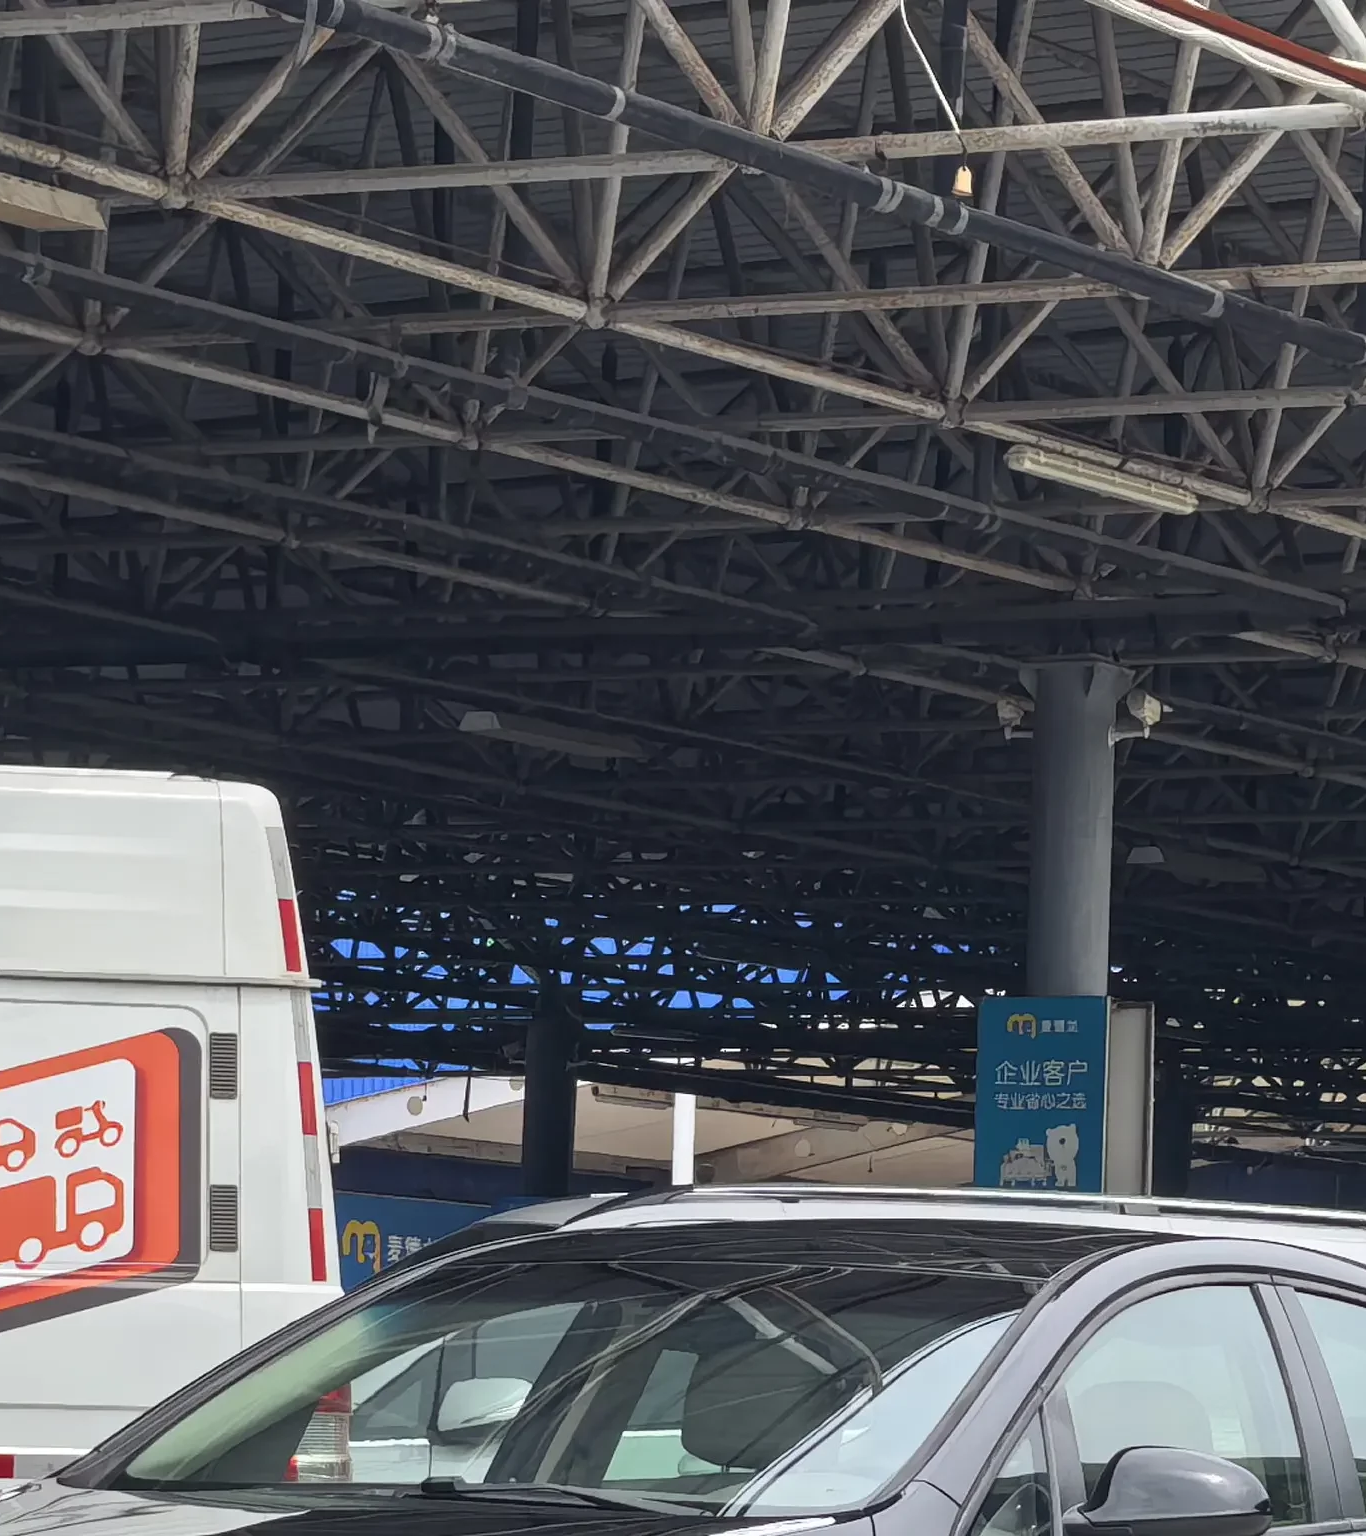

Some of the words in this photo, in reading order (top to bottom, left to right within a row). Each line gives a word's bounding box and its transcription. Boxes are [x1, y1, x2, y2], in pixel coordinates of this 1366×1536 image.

[994, 1059, 1089, 1086] 企业客户
[994, 1091, 1088, 1111] 专业省心之选
